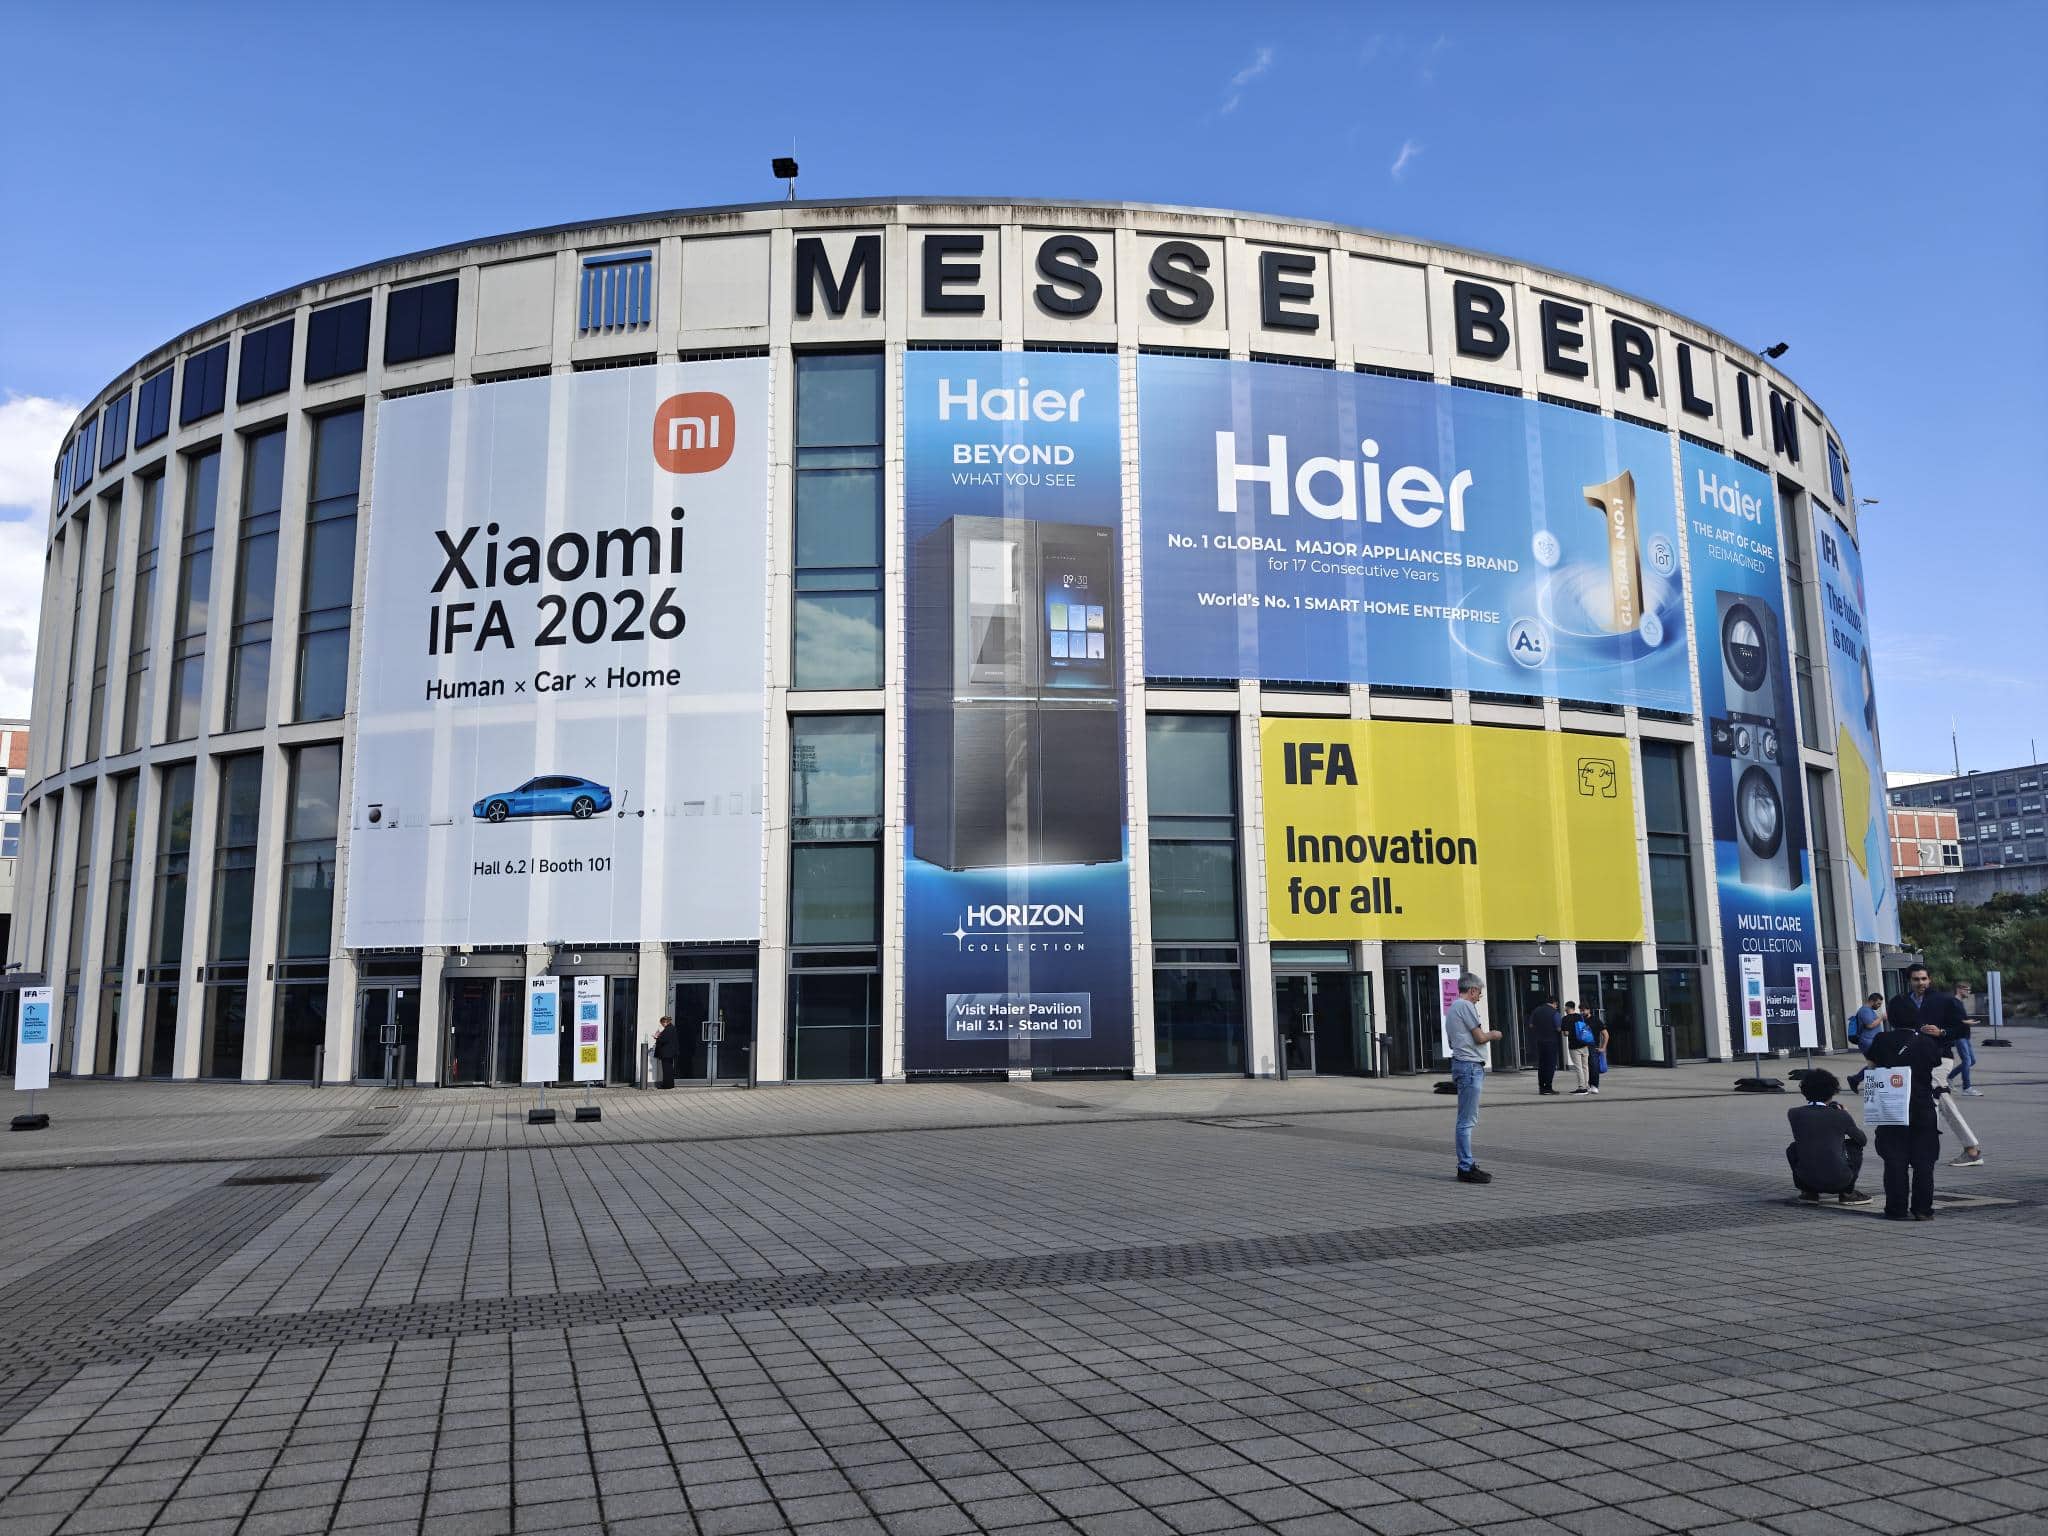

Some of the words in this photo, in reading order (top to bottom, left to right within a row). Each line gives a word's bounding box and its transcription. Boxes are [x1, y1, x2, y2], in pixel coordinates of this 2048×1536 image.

[796, 234, 1319, 331] MESSE
[1453, 279, 1799, 461] BERLIN
[938, 377, 1085, 422] Haier
[953, 444, 1075, 465] BEYOND
[952, 473, 1001, 486] WHAT
[1005, 473, 1040, 486] YOU
[1045, 474, 1076, 487] SEE
[1215, 430, 1473, 532] Haier
[1698, 469, 1762, 524] Haier
[430, 507, 685, 593] Xiaomi
[1693, 520, 1713, 538] THE
[1716, 528, 1735, 545] ART
[1737, 535, 1749, 549] OF
[1821, 529, 1839, 571] IFA
[1168, 534, 1197, 548] No.
[1201, 535, 1208, 548] 1
[1213, 535, 1286, 552] GLOBAL
[1296, 540, 1357, 557] MAJOR
[1362, 544, 1462, 566] APPLIANCES
[1466, 554, 1519, 573] BRAND
[1708, 544, 1766, 573] REIMAGINED
[1268, 557, 1288, 571] for
[1292, 559, 1307, 572] 17
[1311, 560, 1399, 579] Consecutive
[1402, 567, 1440, 582] Years
[1615, 545, 1632, 626] GLOBAL
[1826, 582, 1844, 618] The
[428, 600, 515, 655] IFA
[534, 587, 686, 646] 2026
[1198, 592, 1260, 607] World's
[1264, 595, 1290, 609] No.
[1294, 596, 1300, 609] 1
[1304, 597, 1361, 613] SMART
[1363, 601, 1410, 616] HOME
[1413, 605, 1500, 625] ENTERPRISE
[426, 678, 504, 700] Human
[534, 671, 576, 693] Car
[607, 666, 681, 689] Home
[1283, 742, 1358, 785] IFA
[1286, 826, 1477, 865] Innovation
[474, 861, 500, 875] Hall
[505, 860, 527, 874] 6.2
[539, 858, 583, 873] Booth
[588, 857, 611, 871] 101
[1288, 877, 1340, 914] for
[1350, 877, 1403, 914] all.
[967, 905, 1083, 926] HORIZON
[1738, 914, 1773, 930] MULTI
[1775, 916, 1802, 932] CARE
[573, 954, 582, 964] D
[968, 943, 1084, 951] COLLECTION
[1742, 938, 1802, 952] COLLECTION
[460, 957, 468, 966] D
[956, 1003, 986, 1015] Visit
[989, 1003, 1025, 1015] Haier
[1028, 1003, 1082, 1015] Pavilion
[1780, 1008, 1796, 1018] Stand
[956, 1020, 982, 1031] Hall
[987, 1020, 1003, 1031] 3.1
[1019, 1019, 1058, 1031] Stand
[1063, 1019, 1082, 1030] 101
